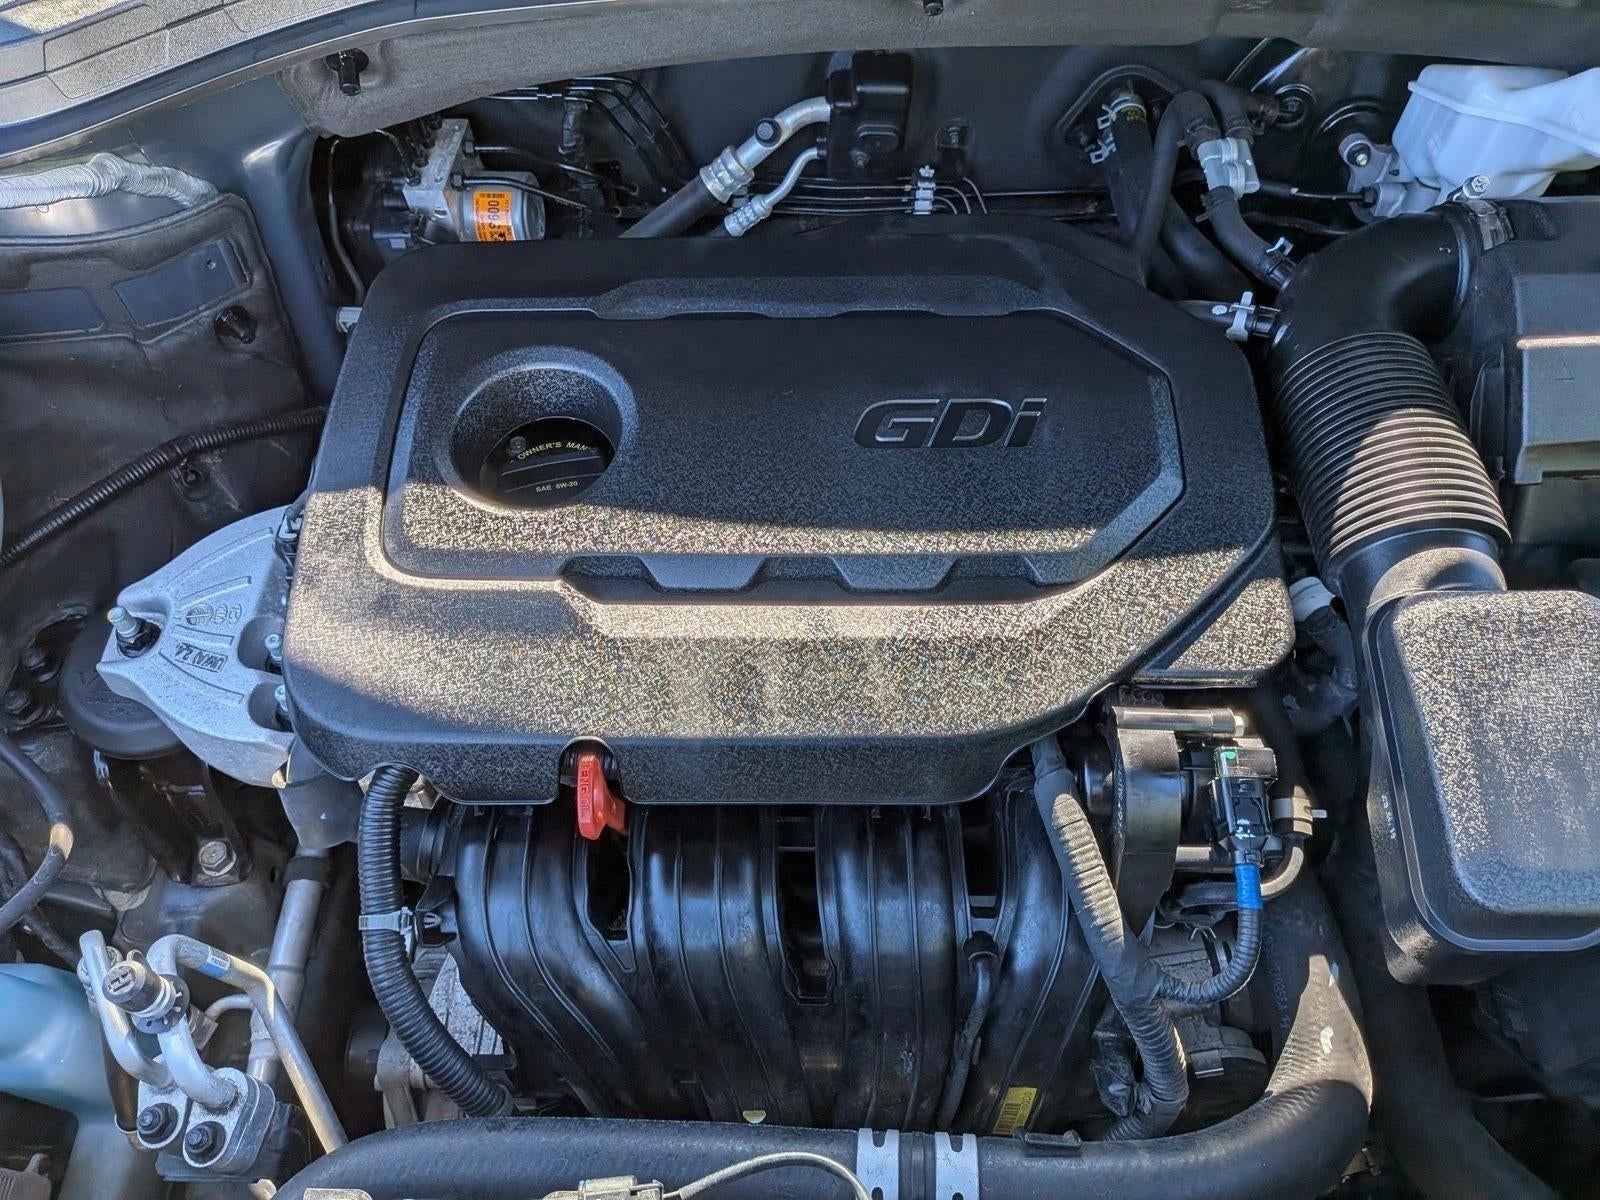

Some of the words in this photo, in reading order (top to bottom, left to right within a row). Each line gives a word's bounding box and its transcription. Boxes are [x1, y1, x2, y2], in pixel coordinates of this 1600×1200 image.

[853, 397, 1047, 448] GDi
[517, 441, 562, 460] OWNER'S
[535, 485, 552, 494] SAE
[555, 481, 578, 490] 5W-20
[579, 768, 590, 793] ENG
[580, 797, 590, 817] OIL
